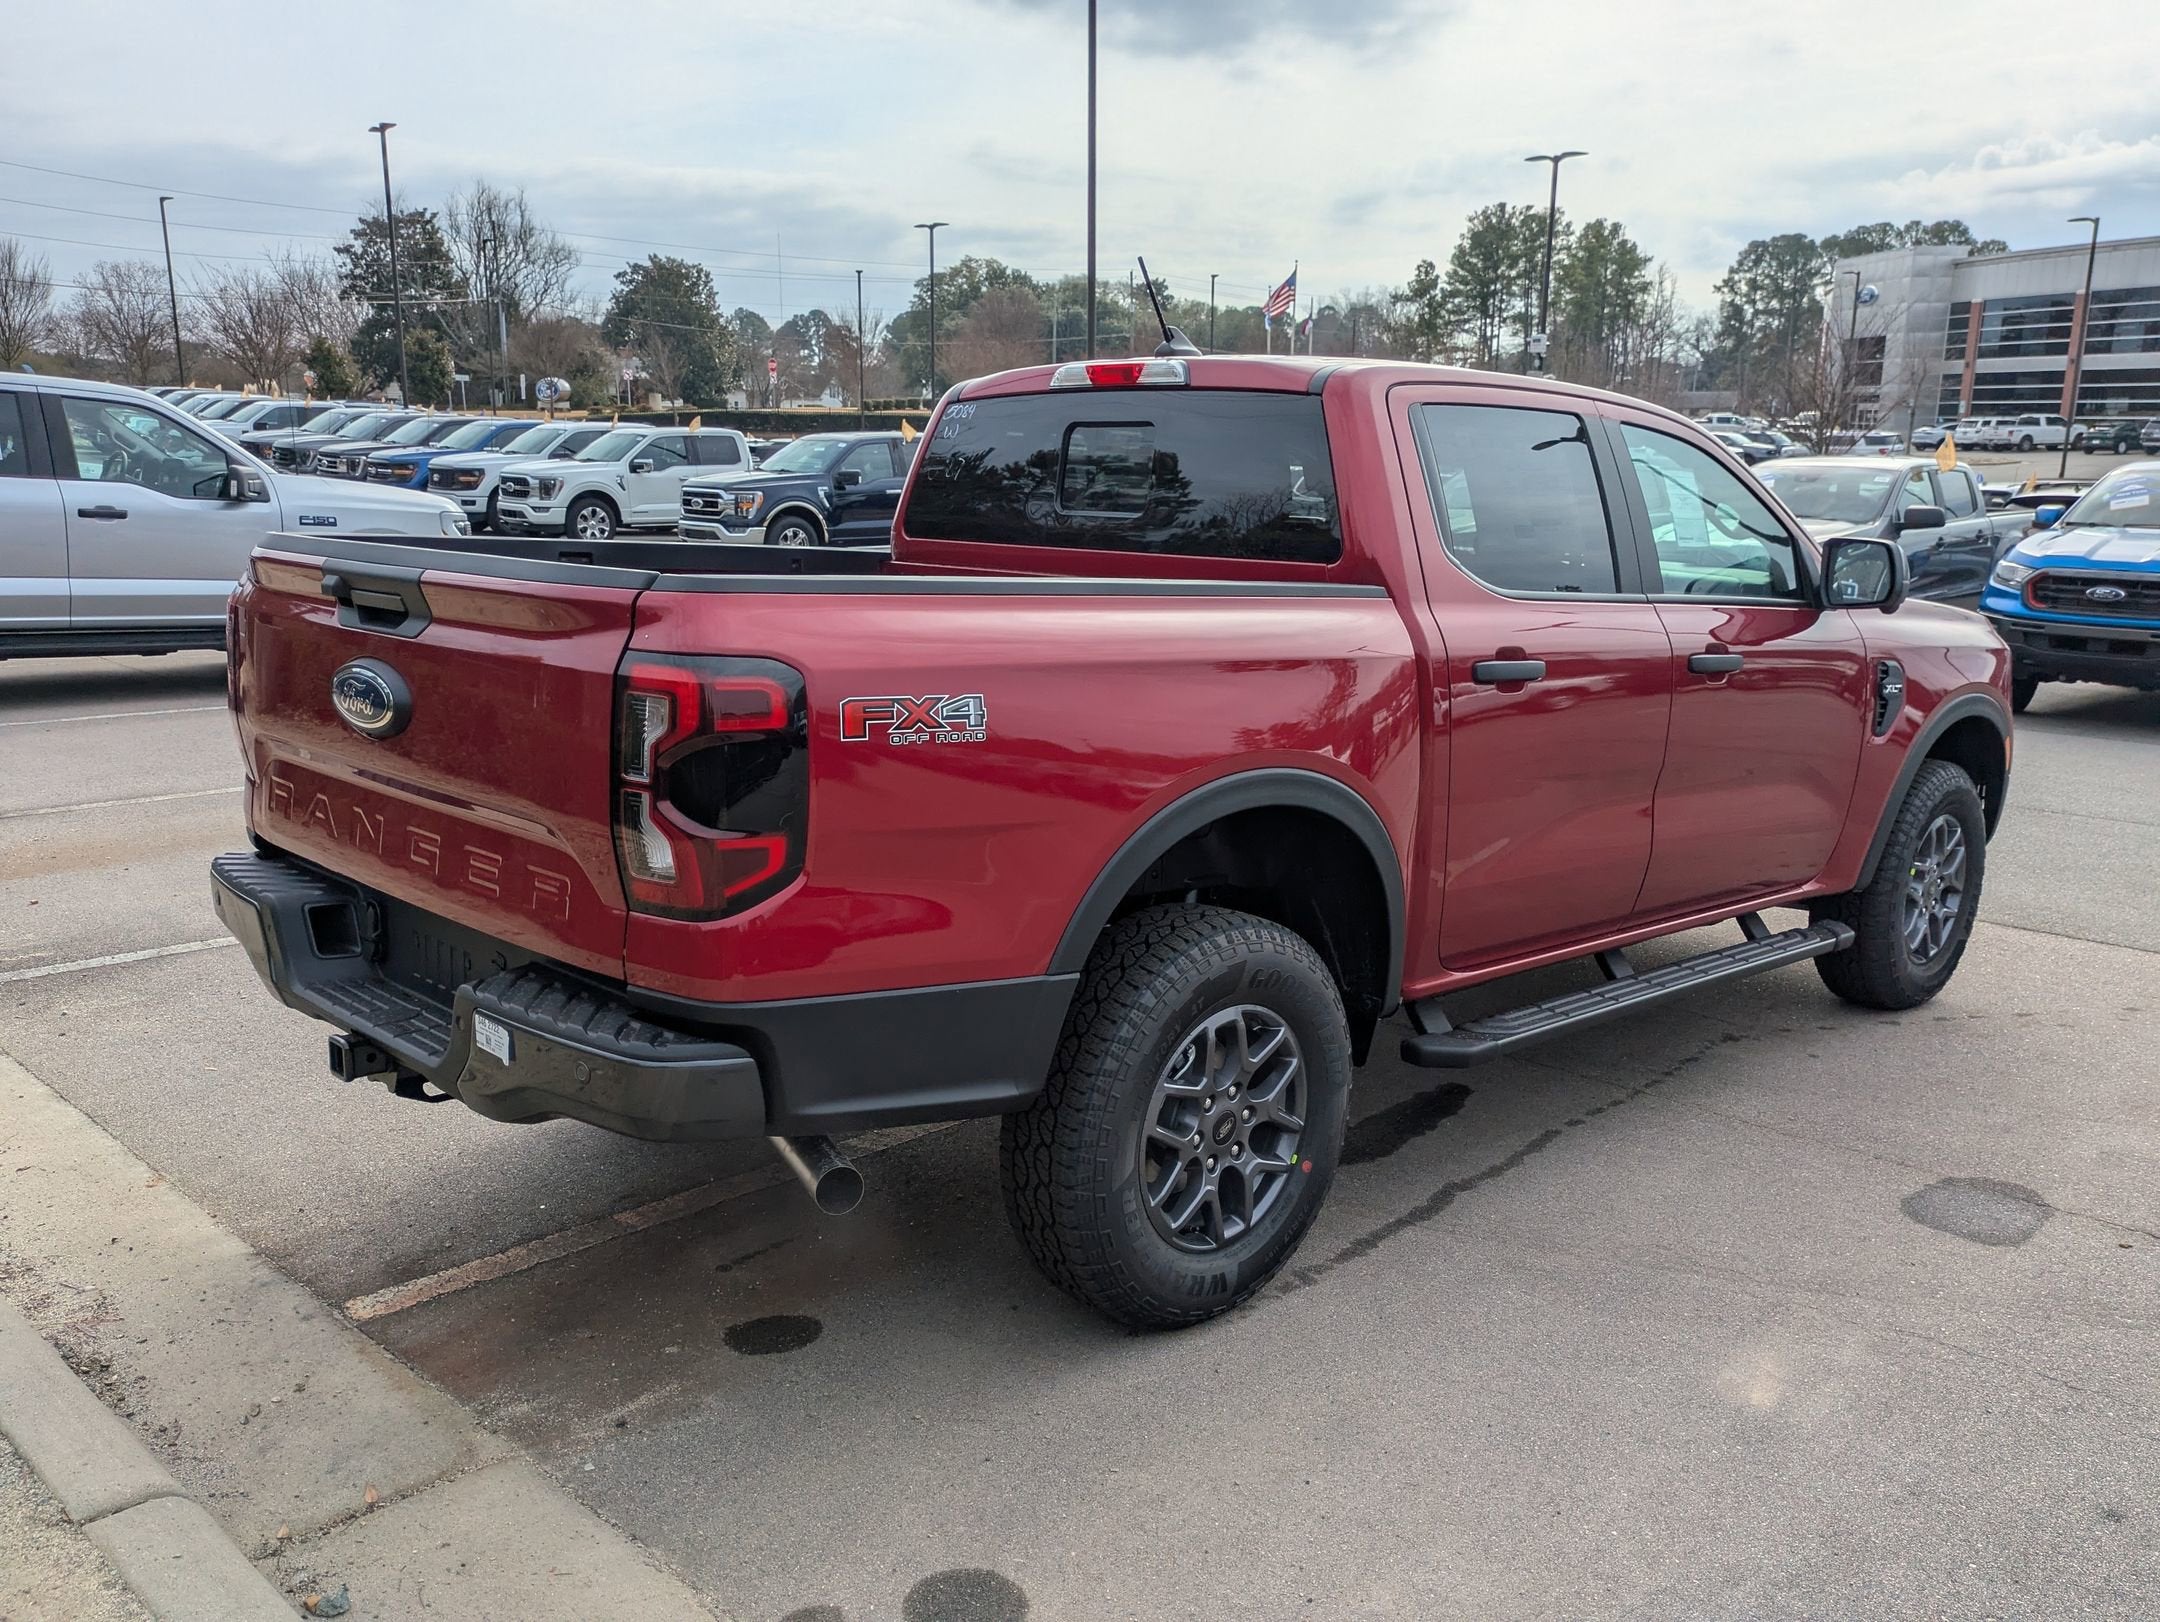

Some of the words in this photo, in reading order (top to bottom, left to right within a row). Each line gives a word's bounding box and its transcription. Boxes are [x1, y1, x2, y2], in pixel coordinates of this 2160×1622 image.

[943, 404, 976, 420] 5084
[340, 679, 375, 716] Ford
[1883, 684, 1903, 693] XLT
[840, 694, 986, 742] FX4
[889, 732, 929, 746] OFF
[936, 730, 987, 743] ROAD
[269, 775, 571, 920] RANGER
